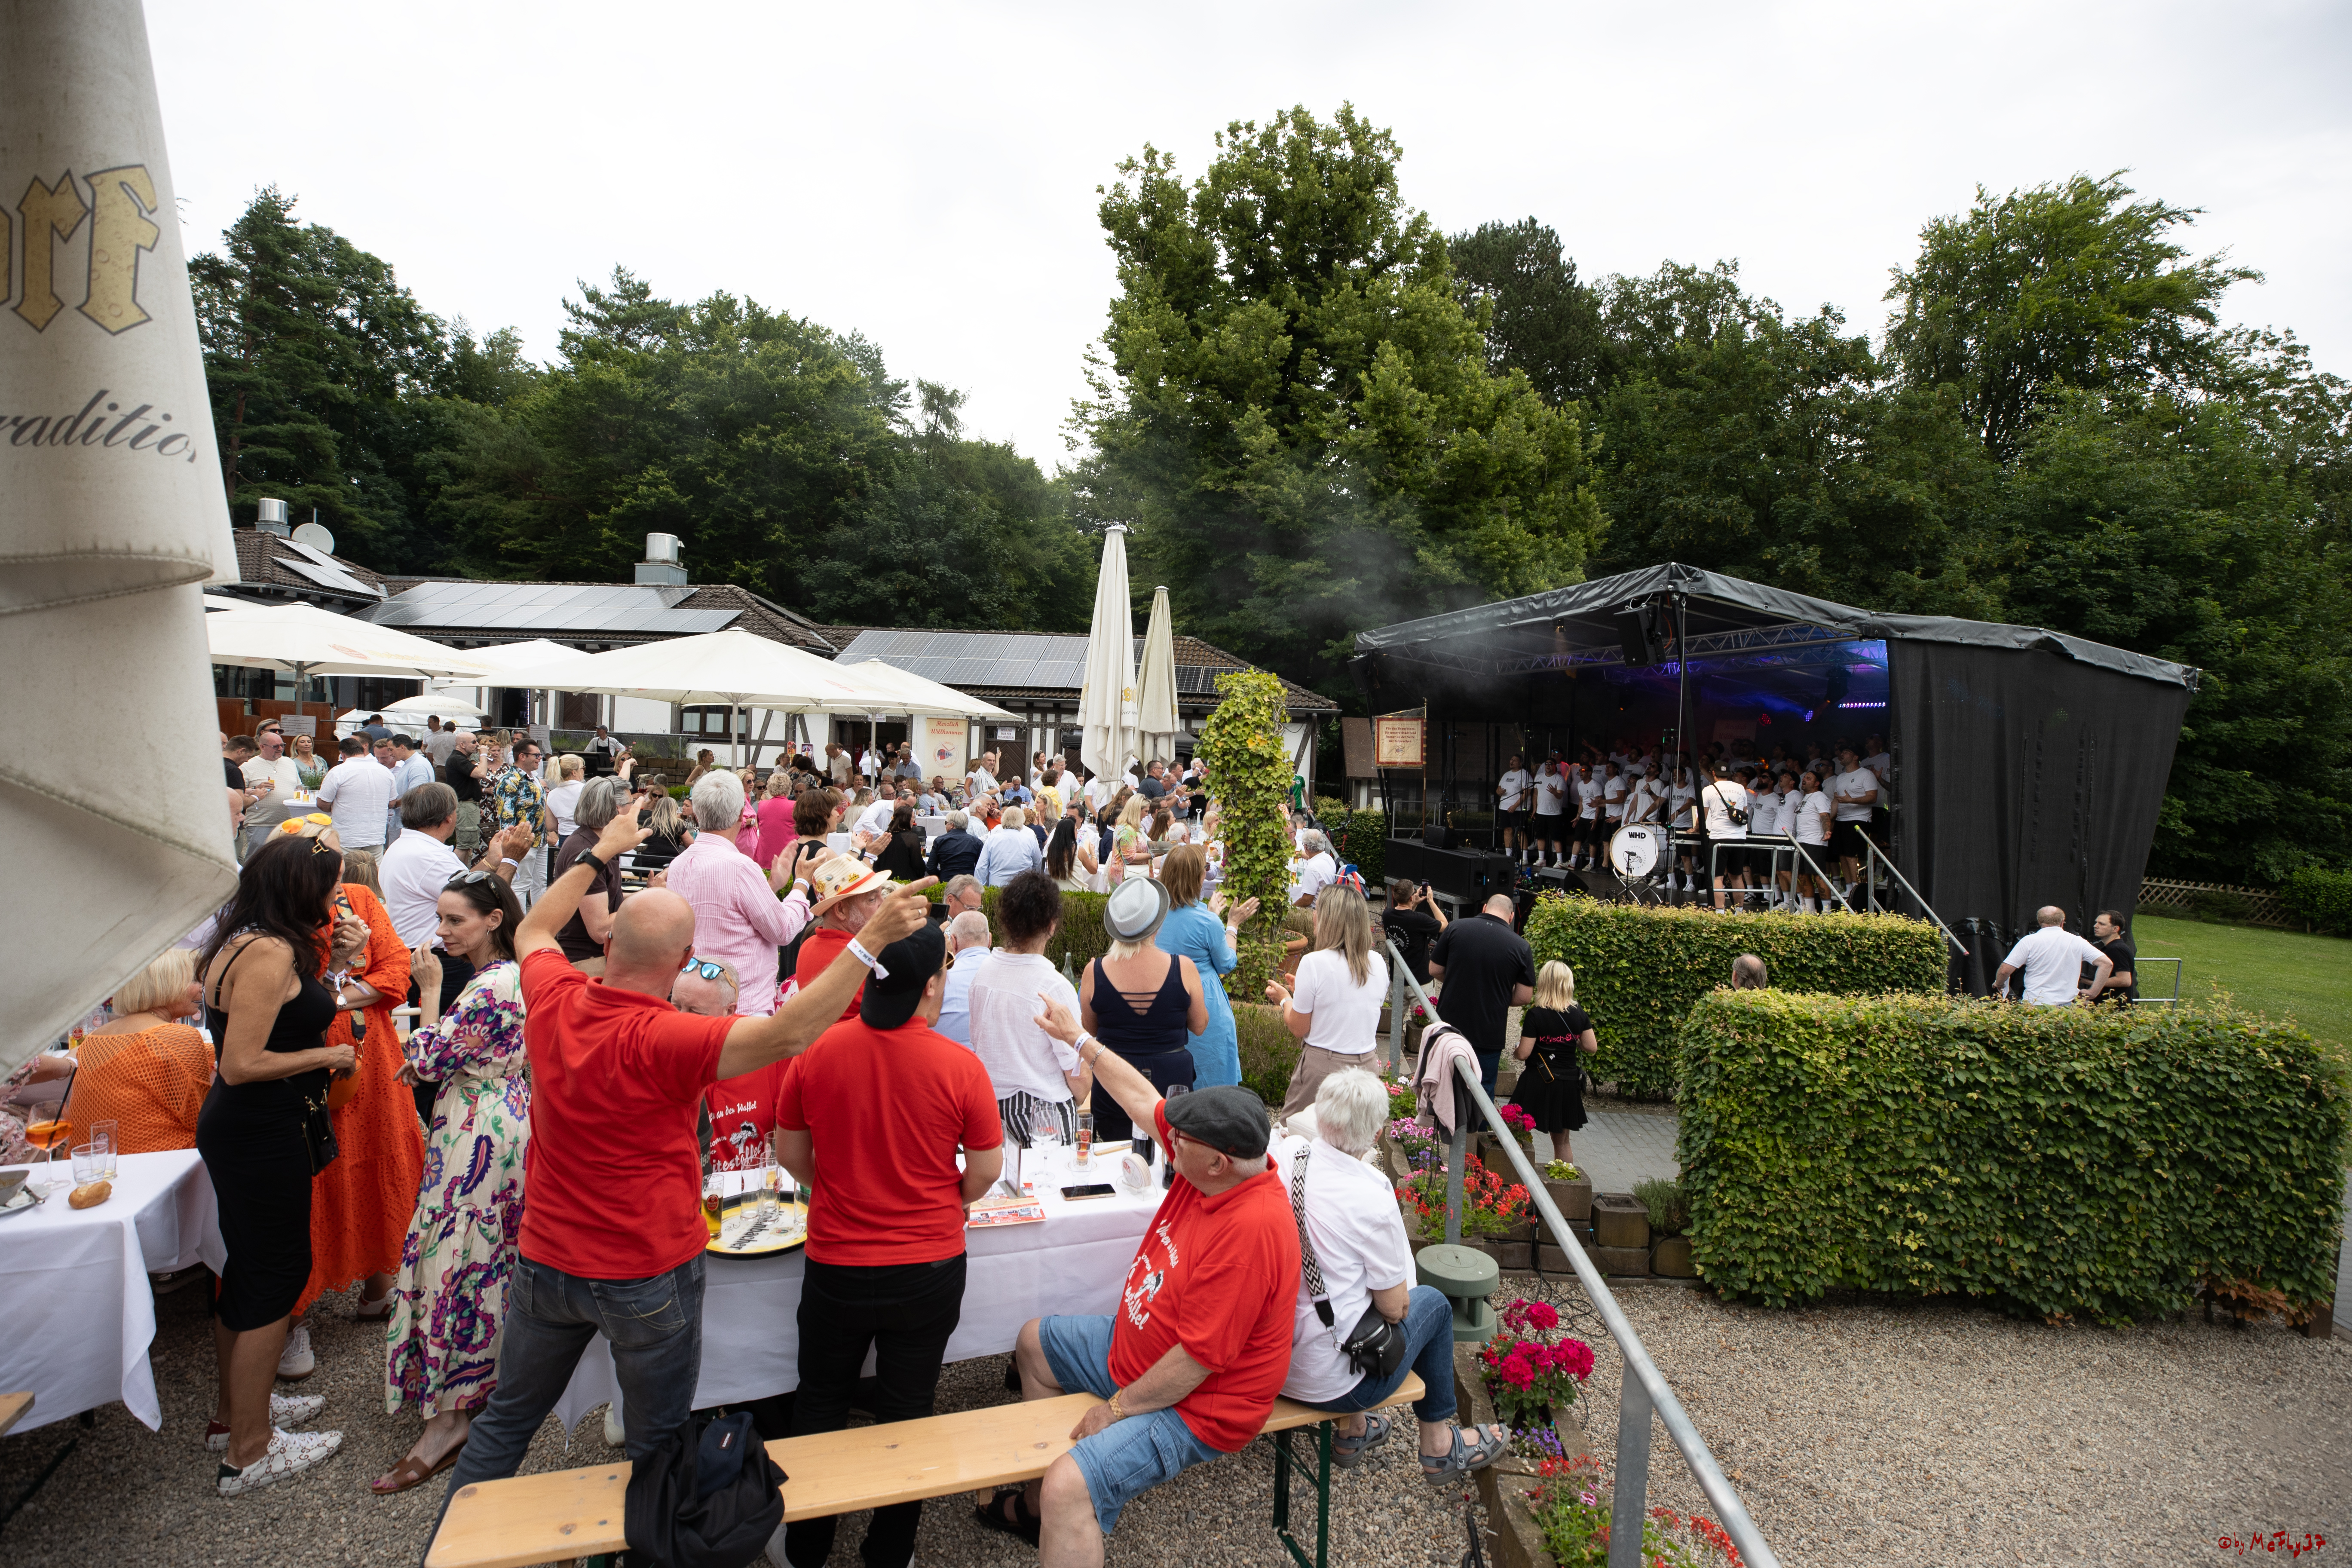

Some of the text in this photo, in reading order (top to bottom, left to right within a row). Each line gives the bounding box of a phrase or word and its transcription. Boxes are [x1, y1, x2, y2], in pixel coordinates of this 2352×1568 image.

[717, 1111, 724, 1119] an
[725, 1105, 735, 1116] der
[737, 1100, 757, 1114] Waffel
